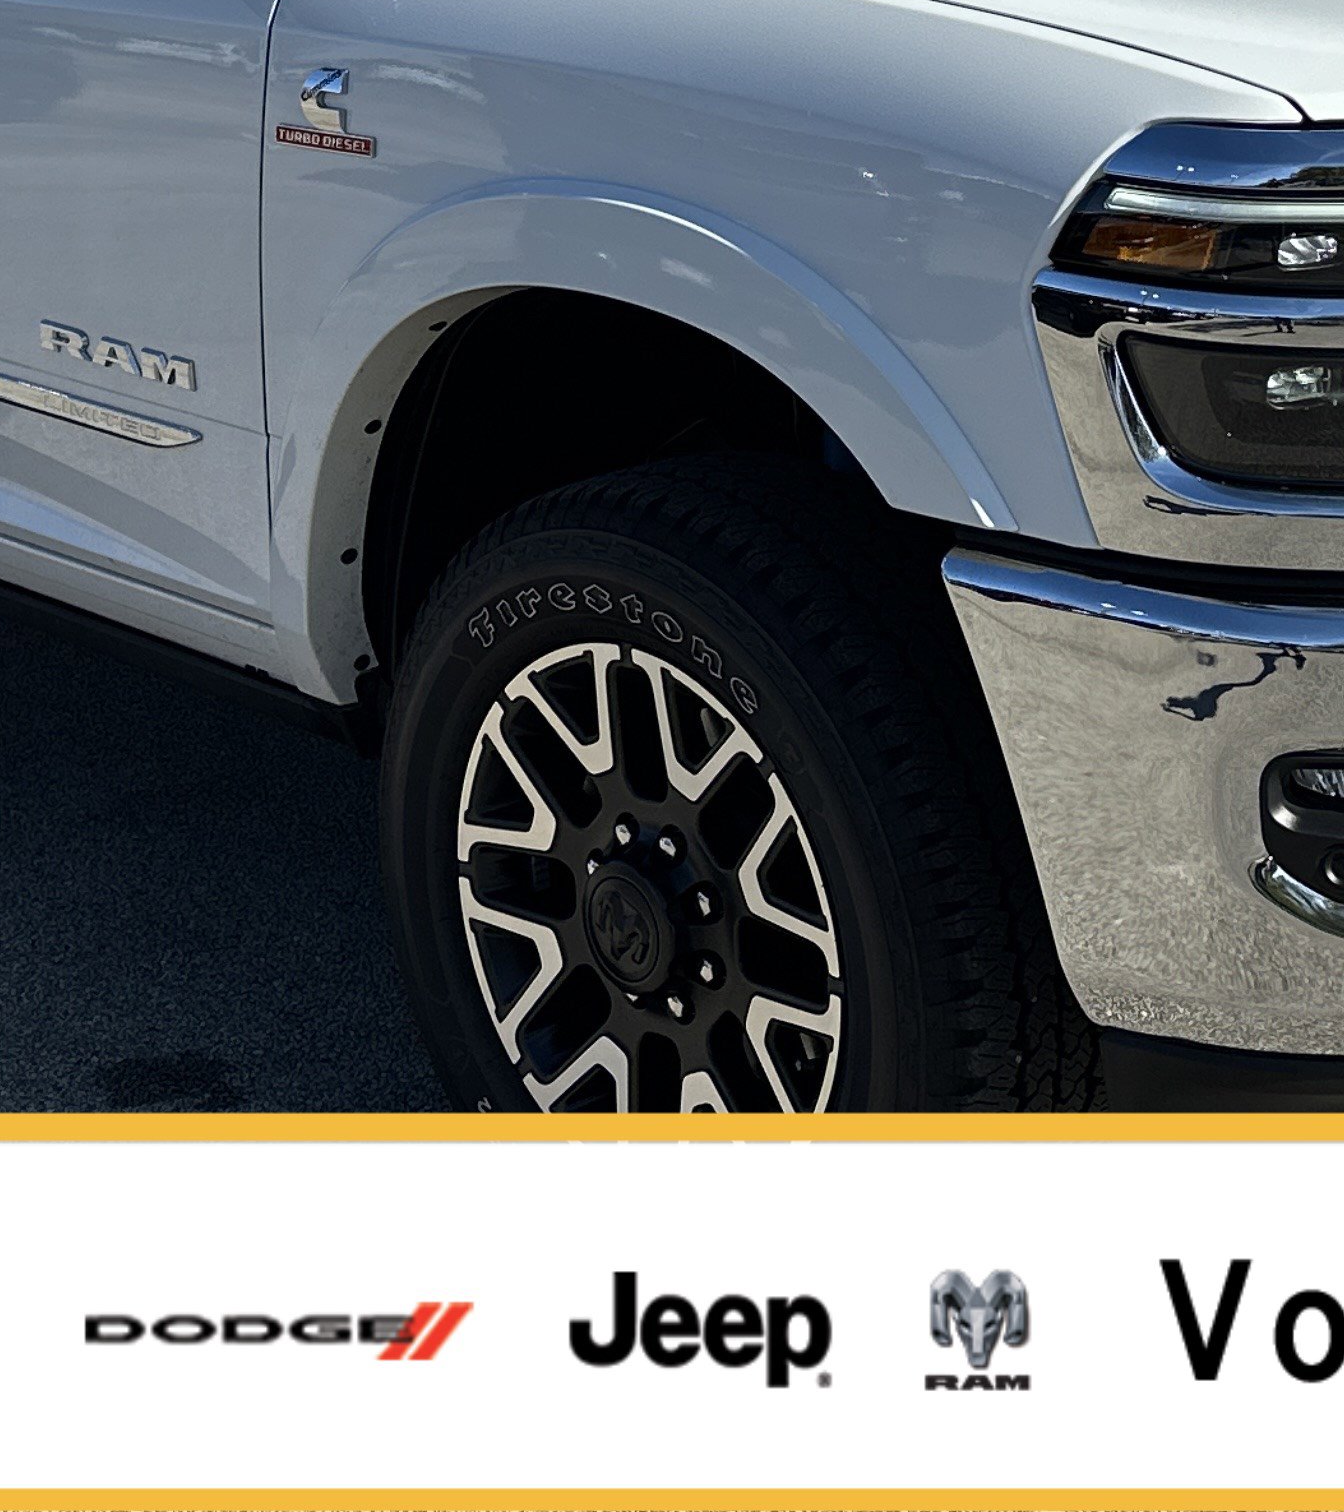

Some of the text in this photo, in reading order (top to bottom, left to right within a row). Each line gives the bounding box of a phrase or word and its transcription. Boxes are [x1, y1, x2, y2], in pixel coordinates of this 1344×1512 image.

[277, 128, 370, 153] TURBO DIESEL
[39, 318, 197, 392] RAM
[467, 581, 759, 716] Firestone
